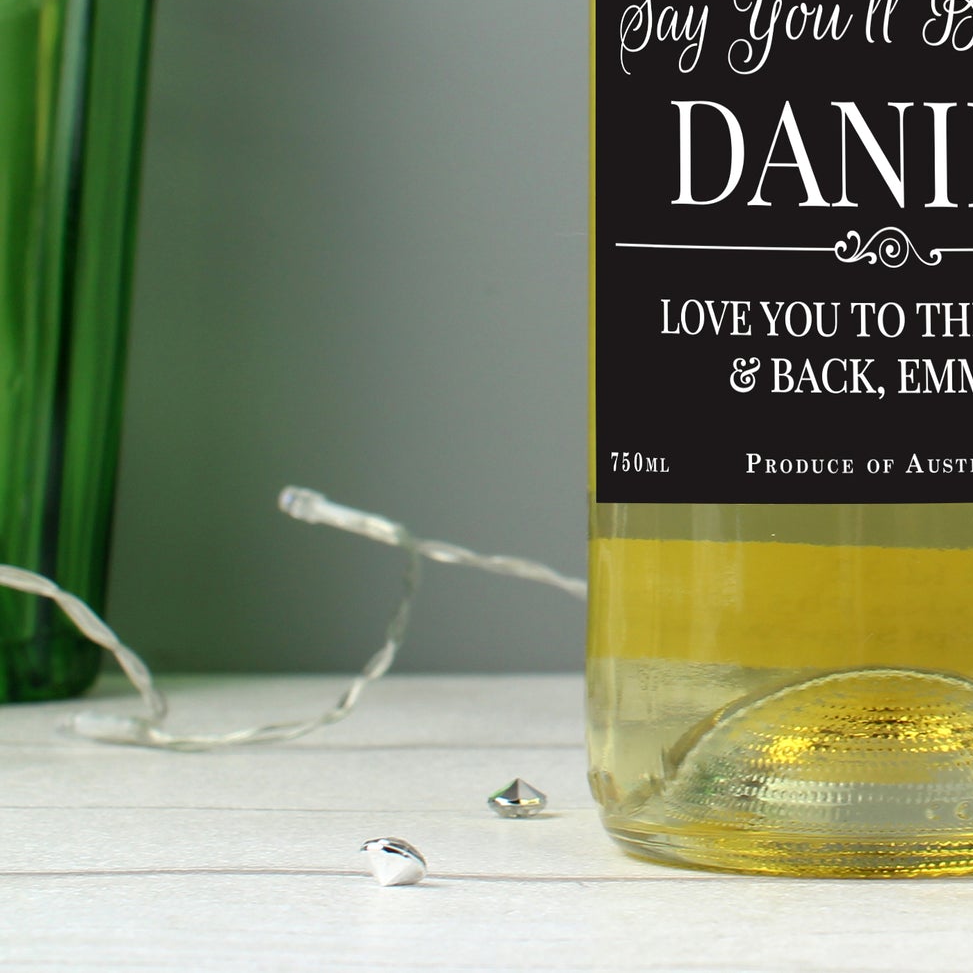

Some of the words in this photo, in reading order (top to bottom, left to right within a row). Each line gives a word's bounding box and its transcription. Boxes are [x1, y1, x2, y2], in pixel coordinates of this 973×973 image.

[660, 298, 752, 336] LOVE
[760, 300, 841, 338] YOU
[850, 301, 906, 338] TO
[729, 356, 761, 394] &
[770, 357, 886, 400] BACK,
[610, 451, 670, 473] 750ML
